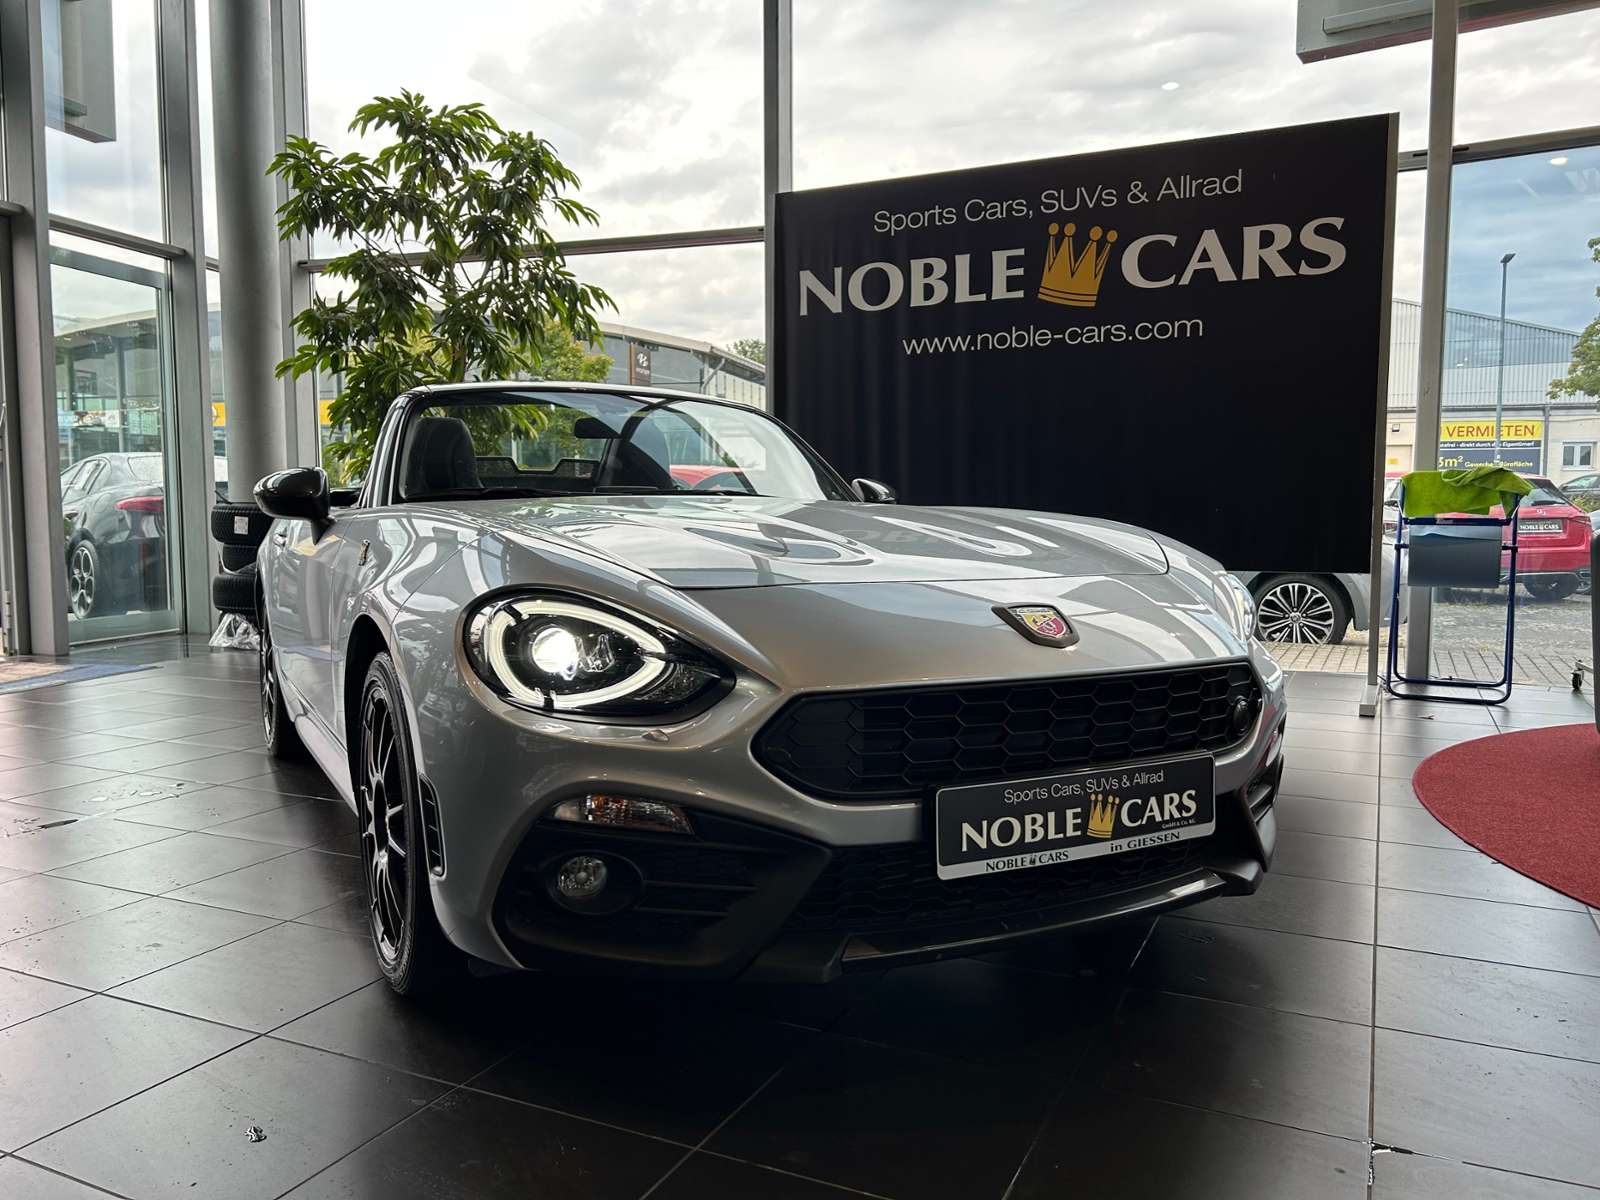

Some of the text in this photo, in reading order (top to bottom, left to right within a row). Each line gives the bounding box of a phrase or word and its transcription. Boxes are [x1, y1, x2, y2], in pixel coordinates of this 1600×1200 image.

[873, 168, 1243, 236] Sports Cars, SUVs & Allrad
[799, 215, 1347, 317] NOBLE CARS
[902, 316, 1204, 356] www.noble-cars.com
[1003, 769, 1164, 805] Sports Cars, SUVs & Allrad
[961, 789, 1198, 852] NOBLE CARS
[985, 849, 1069, 873] NOBLE CARS
[1110, 830, 1181, 853] in GIESSEN
